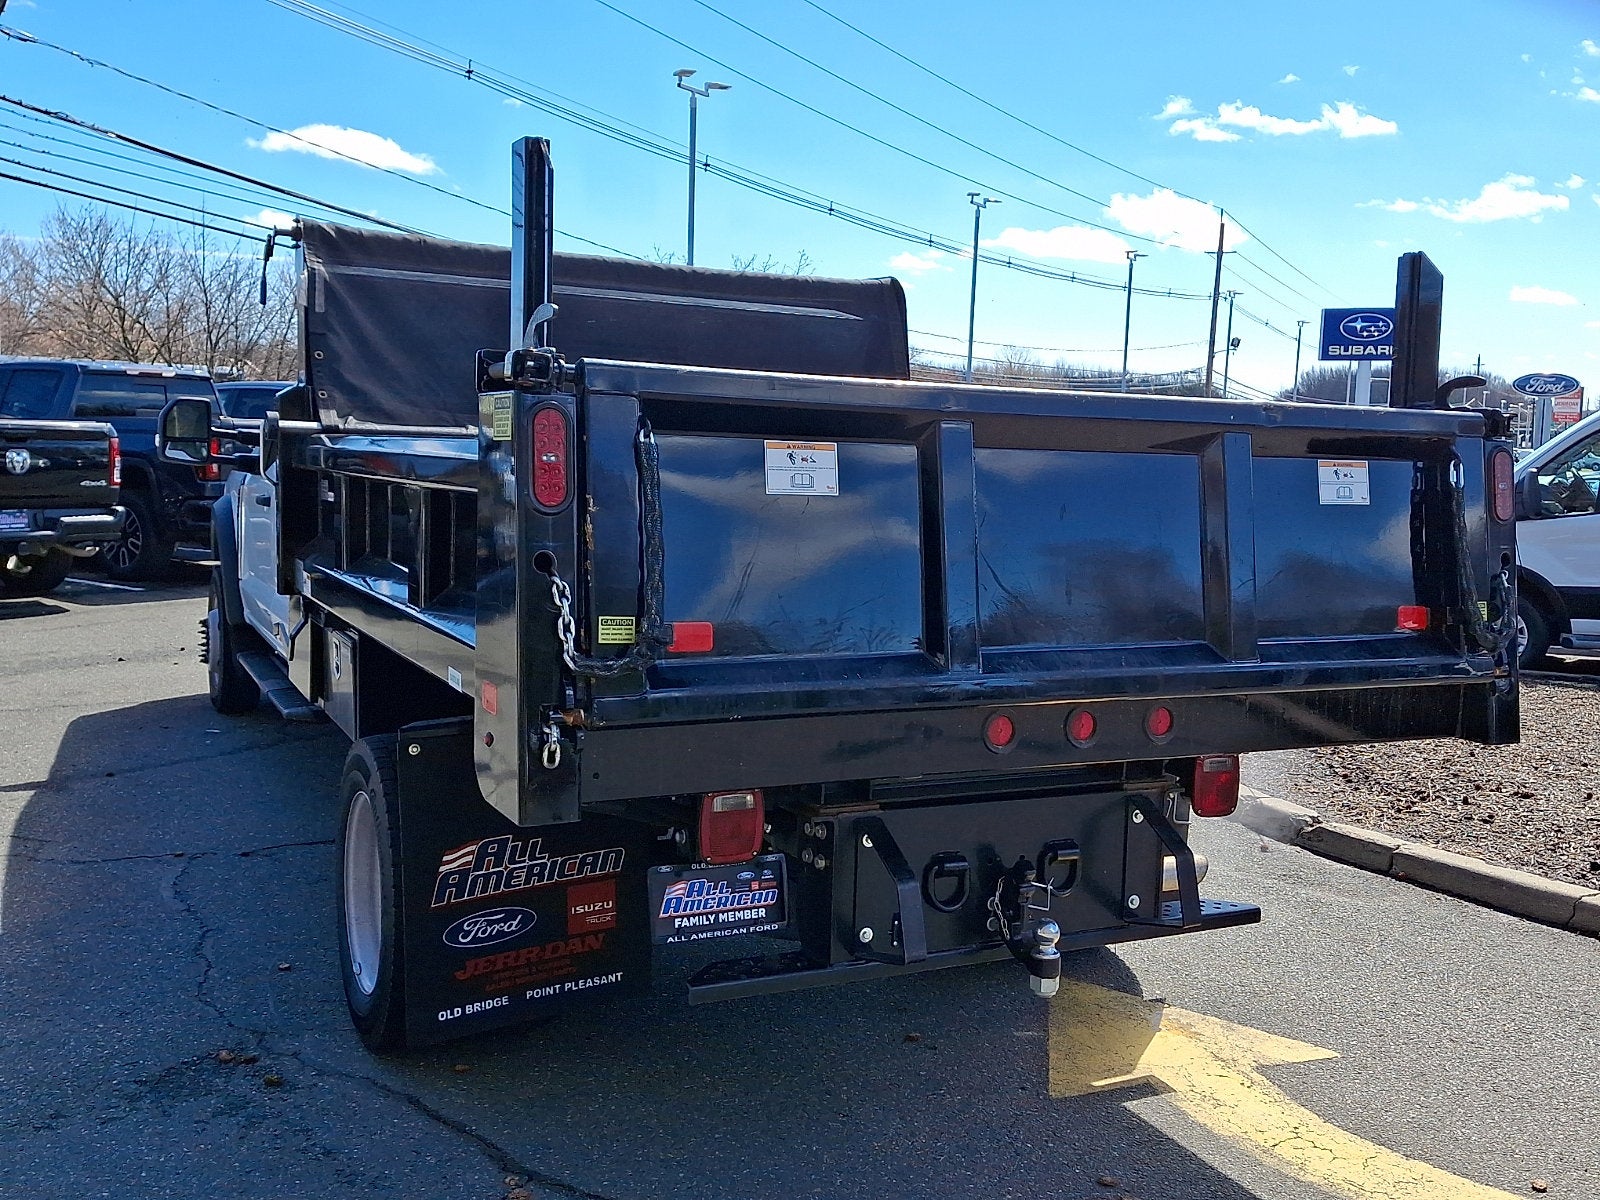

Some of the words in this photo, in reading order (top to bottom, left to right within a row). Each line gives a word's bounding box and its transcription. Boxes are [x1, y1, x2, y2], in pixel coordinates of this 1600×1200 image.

[1525, 376, 1566, 393] Ford
[471, 835, 549, 875] ALL
[431, 848, 625, 908] AMERICAN
[685, 879, 731, 899] ALL
[571, 901, 613, 914] ISUZU
[659, 889, 778, 918] AMERICAN
[458, 914, 522, 942] Ford
[585, 917, 612, 925] TRUCK
[674, 914, 716, 928] FAMILY
[718, 908, 766, 923] MEMBER
[667, 934, 688, 943] ALL
[690, 927, 747, 940] AMERICAN
[750, 923, 779, 933] FORD
[526, 984, 562, 999] POINT
[565, 972, 624, 991] PLEASANT
[437, 1008, 462, 1021] OLD
[465, 996, 510, 1015] BRIDGE
